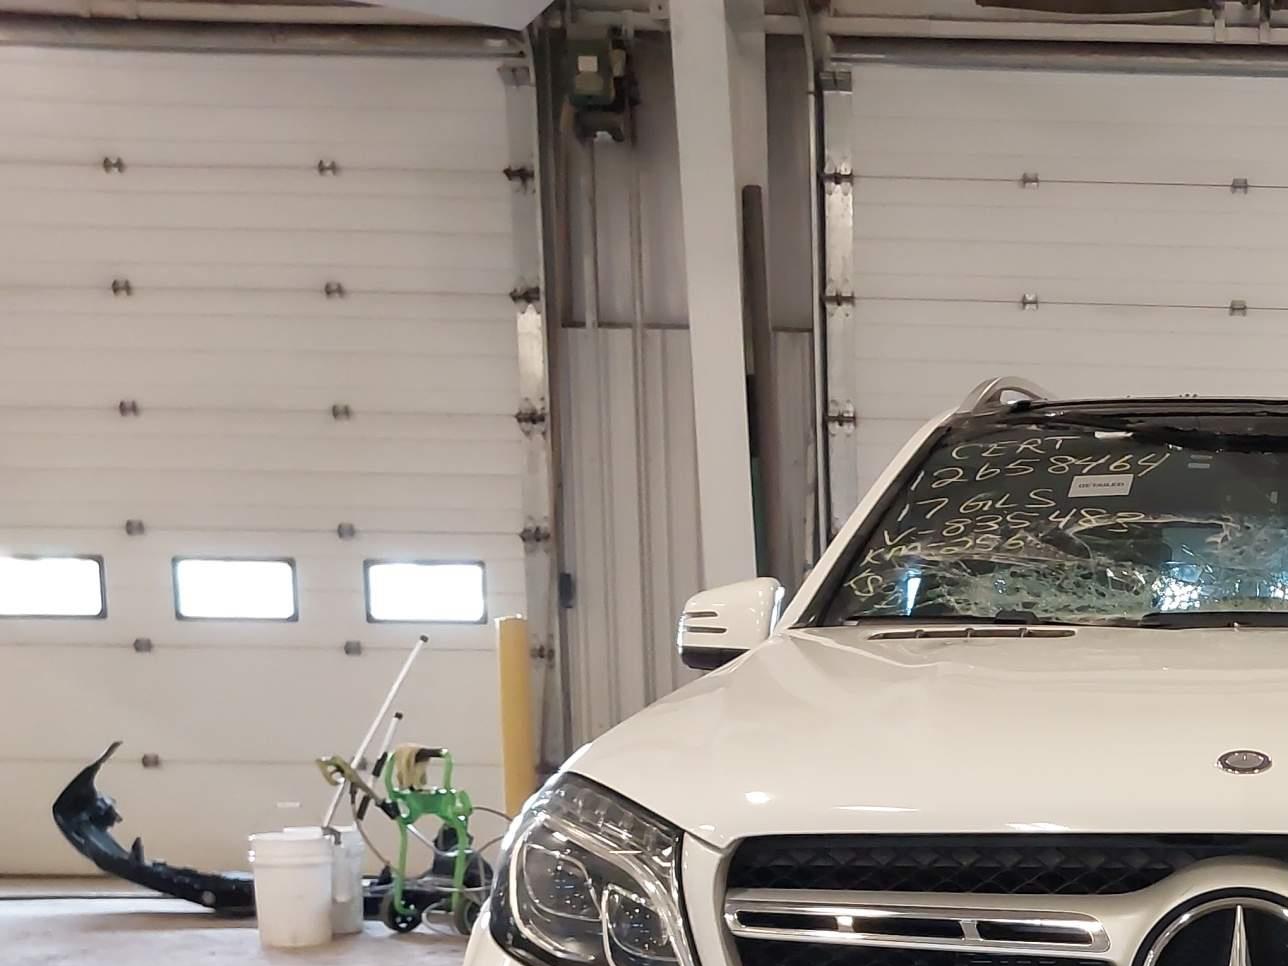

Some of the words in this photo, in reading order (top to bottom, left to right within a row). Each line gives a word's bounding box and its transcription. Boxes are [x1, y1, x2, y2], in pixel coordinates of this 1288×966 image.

[952, 436, 1081, 460] CERT
[911, 453, 1171, 491] 12658464
[897, 498, 949, 521] 17
